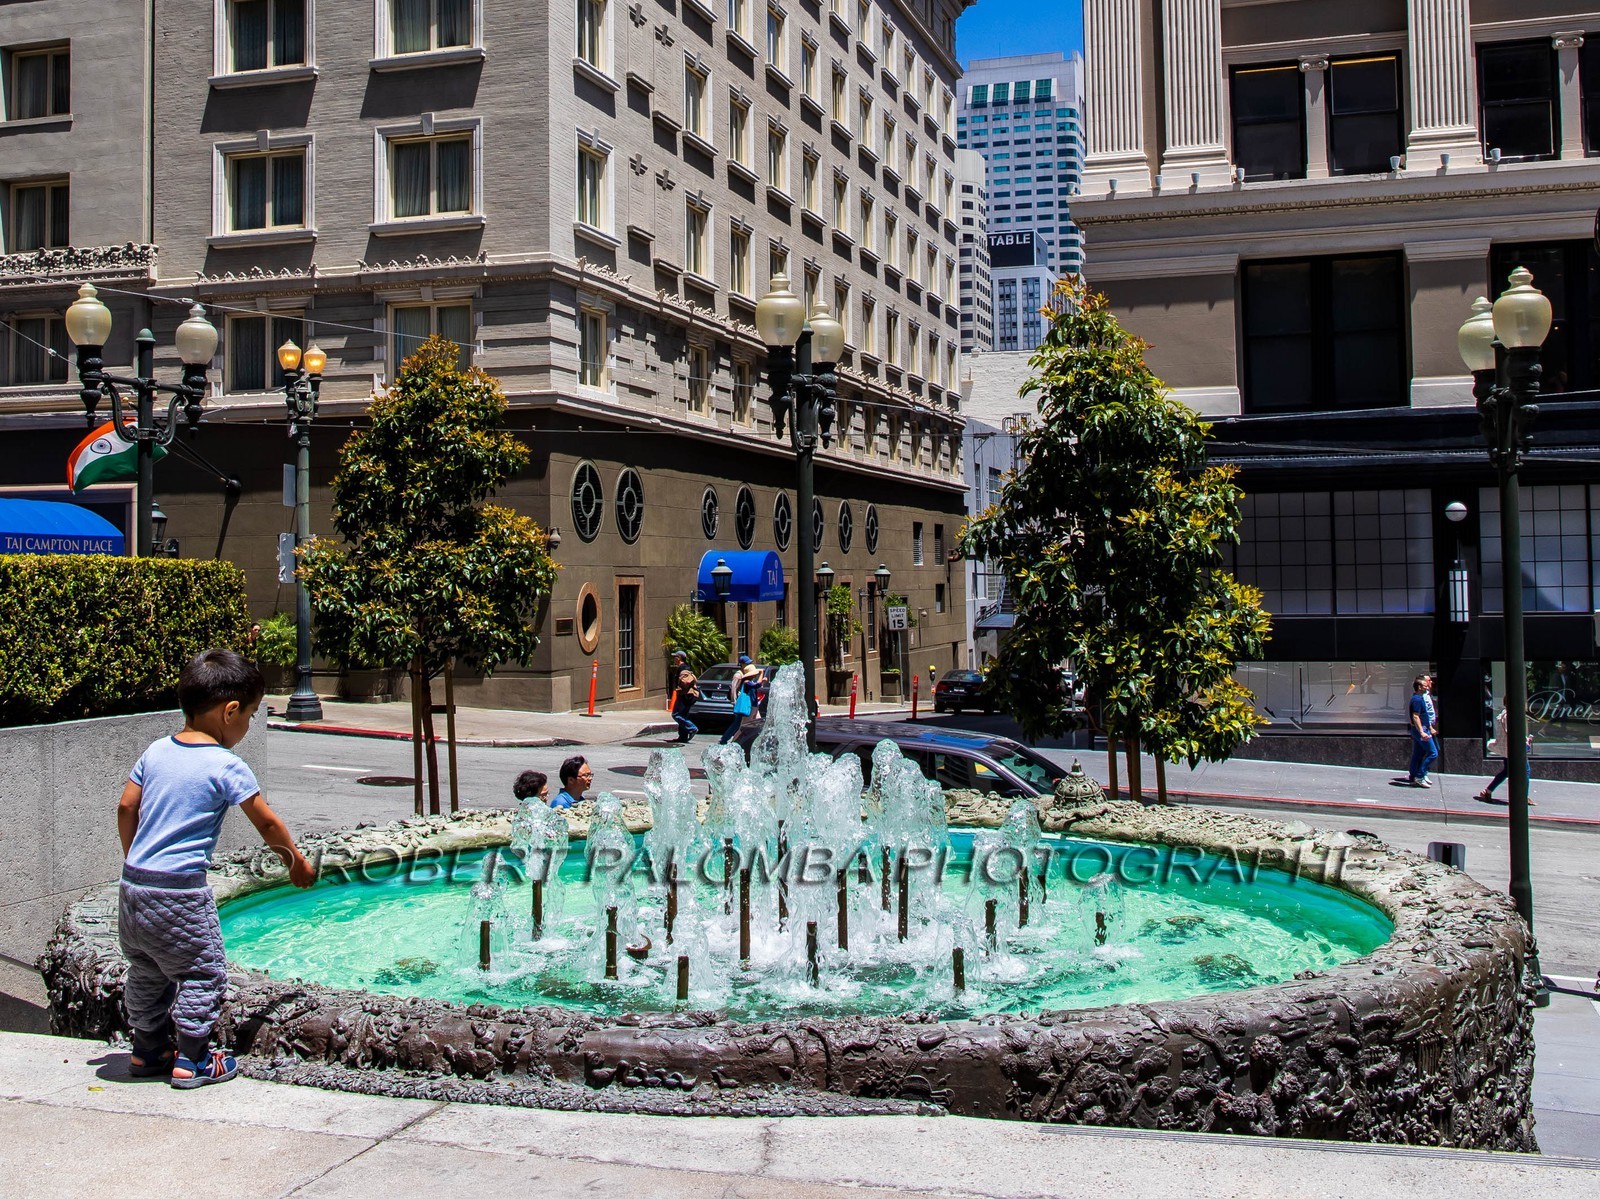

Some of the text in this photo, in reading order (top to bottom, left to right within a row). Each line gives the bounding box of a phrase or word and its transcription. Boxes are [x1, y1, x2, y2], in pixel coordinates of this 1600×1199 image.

[988, 233, 1031, 246] TABLE
[5, 537, 113, 552] TAJ CAMPTON PLACE
[767, 568, 778, 589] TAJ
[892, 619, 905, 629] 15
